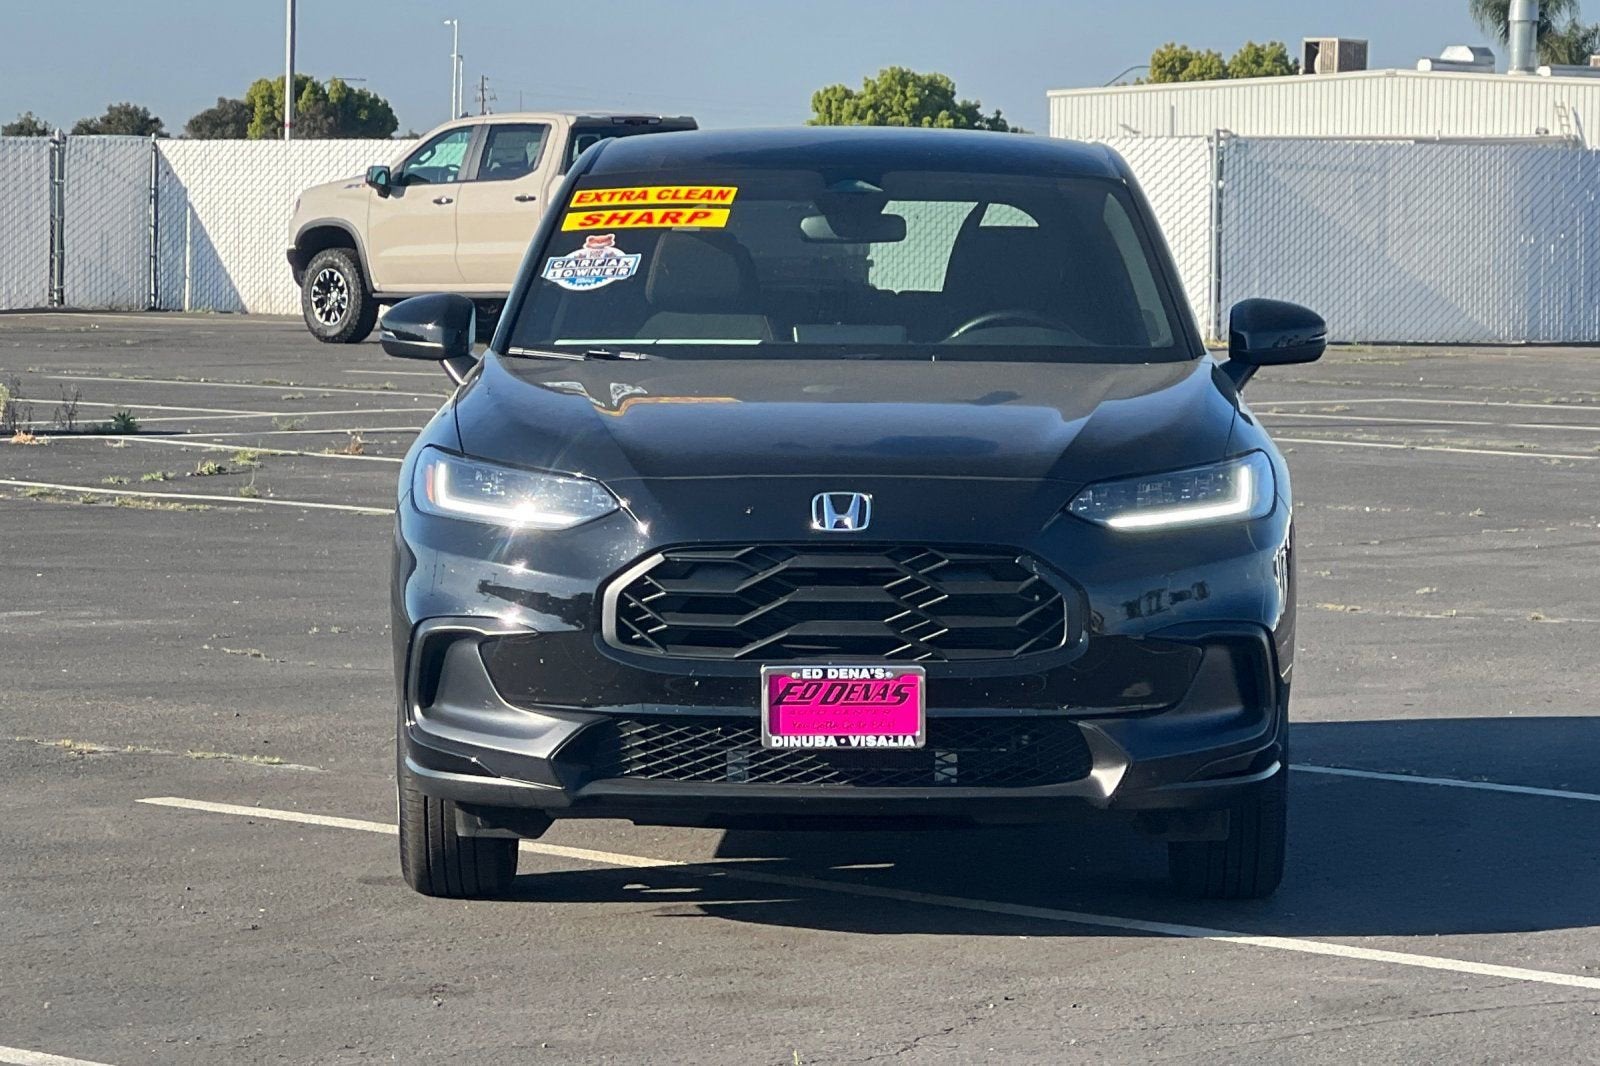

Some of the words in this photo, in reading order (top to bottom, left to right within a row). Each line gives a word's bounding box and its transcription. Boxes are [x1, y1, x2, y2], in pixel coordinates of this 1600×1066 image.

[575, 190, 649, 204] EXTRA
[656, 189, 732, 201] CLEAN
[578, 211, 712, 227] SHARP
[552, 258, 633, 269] CARFAX
[562, 267, 630, 277] OWNER
[802, 669, 823, 679] ED
[827, 668, 885, 679] DENA'S
[772, 683, 823, 705] ED
[818, 683, 916, 705] DENA'S
[772, 736, 837, 747] DINUBA
[849, 736, 915, 747] VISALIA
